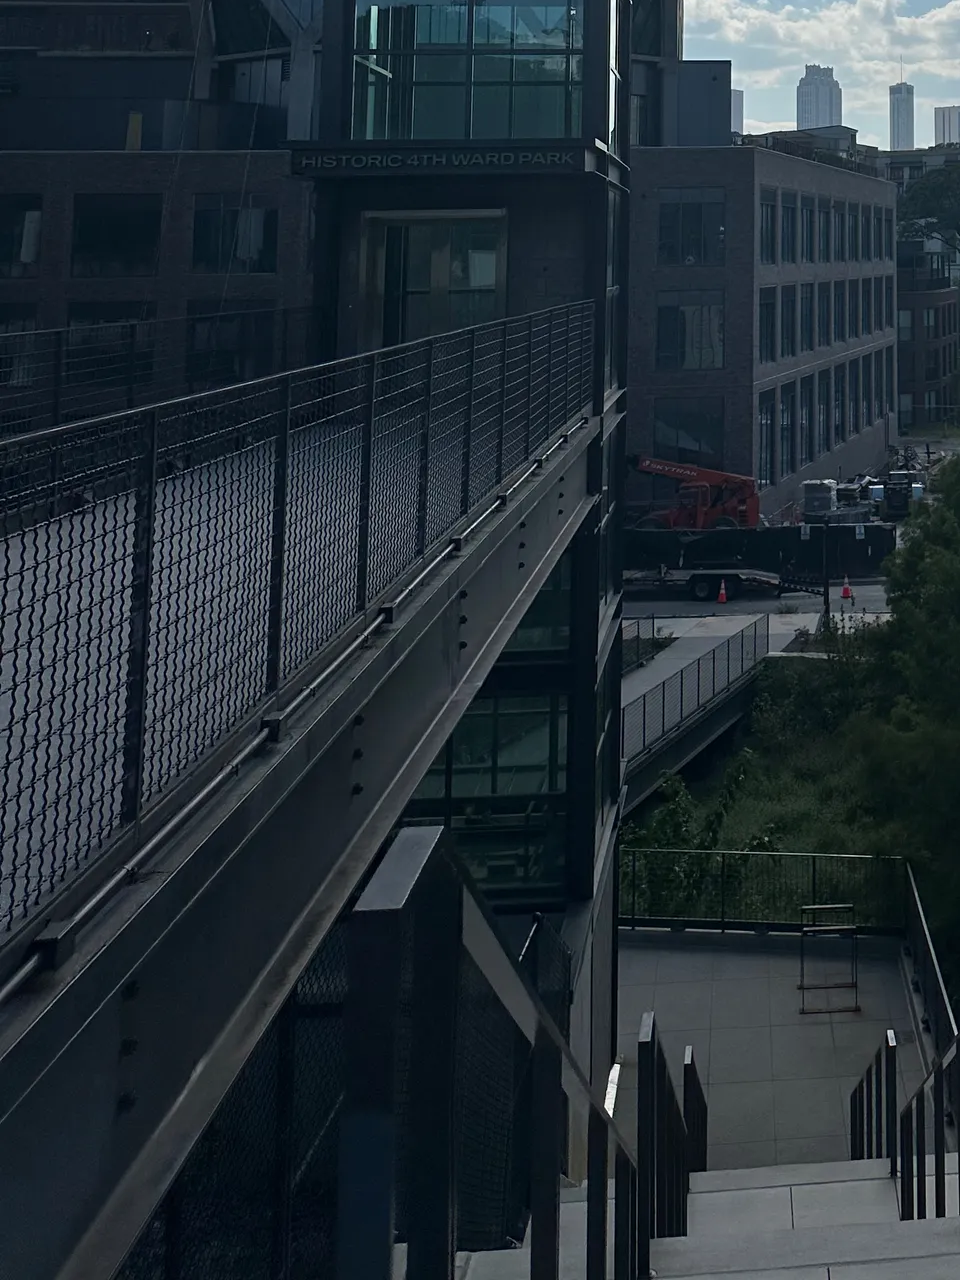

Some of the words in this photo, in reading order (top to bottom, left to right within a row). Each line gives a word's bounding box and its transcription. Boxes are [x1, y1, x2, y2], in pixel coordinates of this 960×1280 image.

[301, 154, 403, 169] HISTORIC
[406, 153, 447, 166] 4TH
[452, 152, 514, 166] WARD
[519, 151, 574, 165] PARK
[651, 463, 697, 476] SKYTRAK
